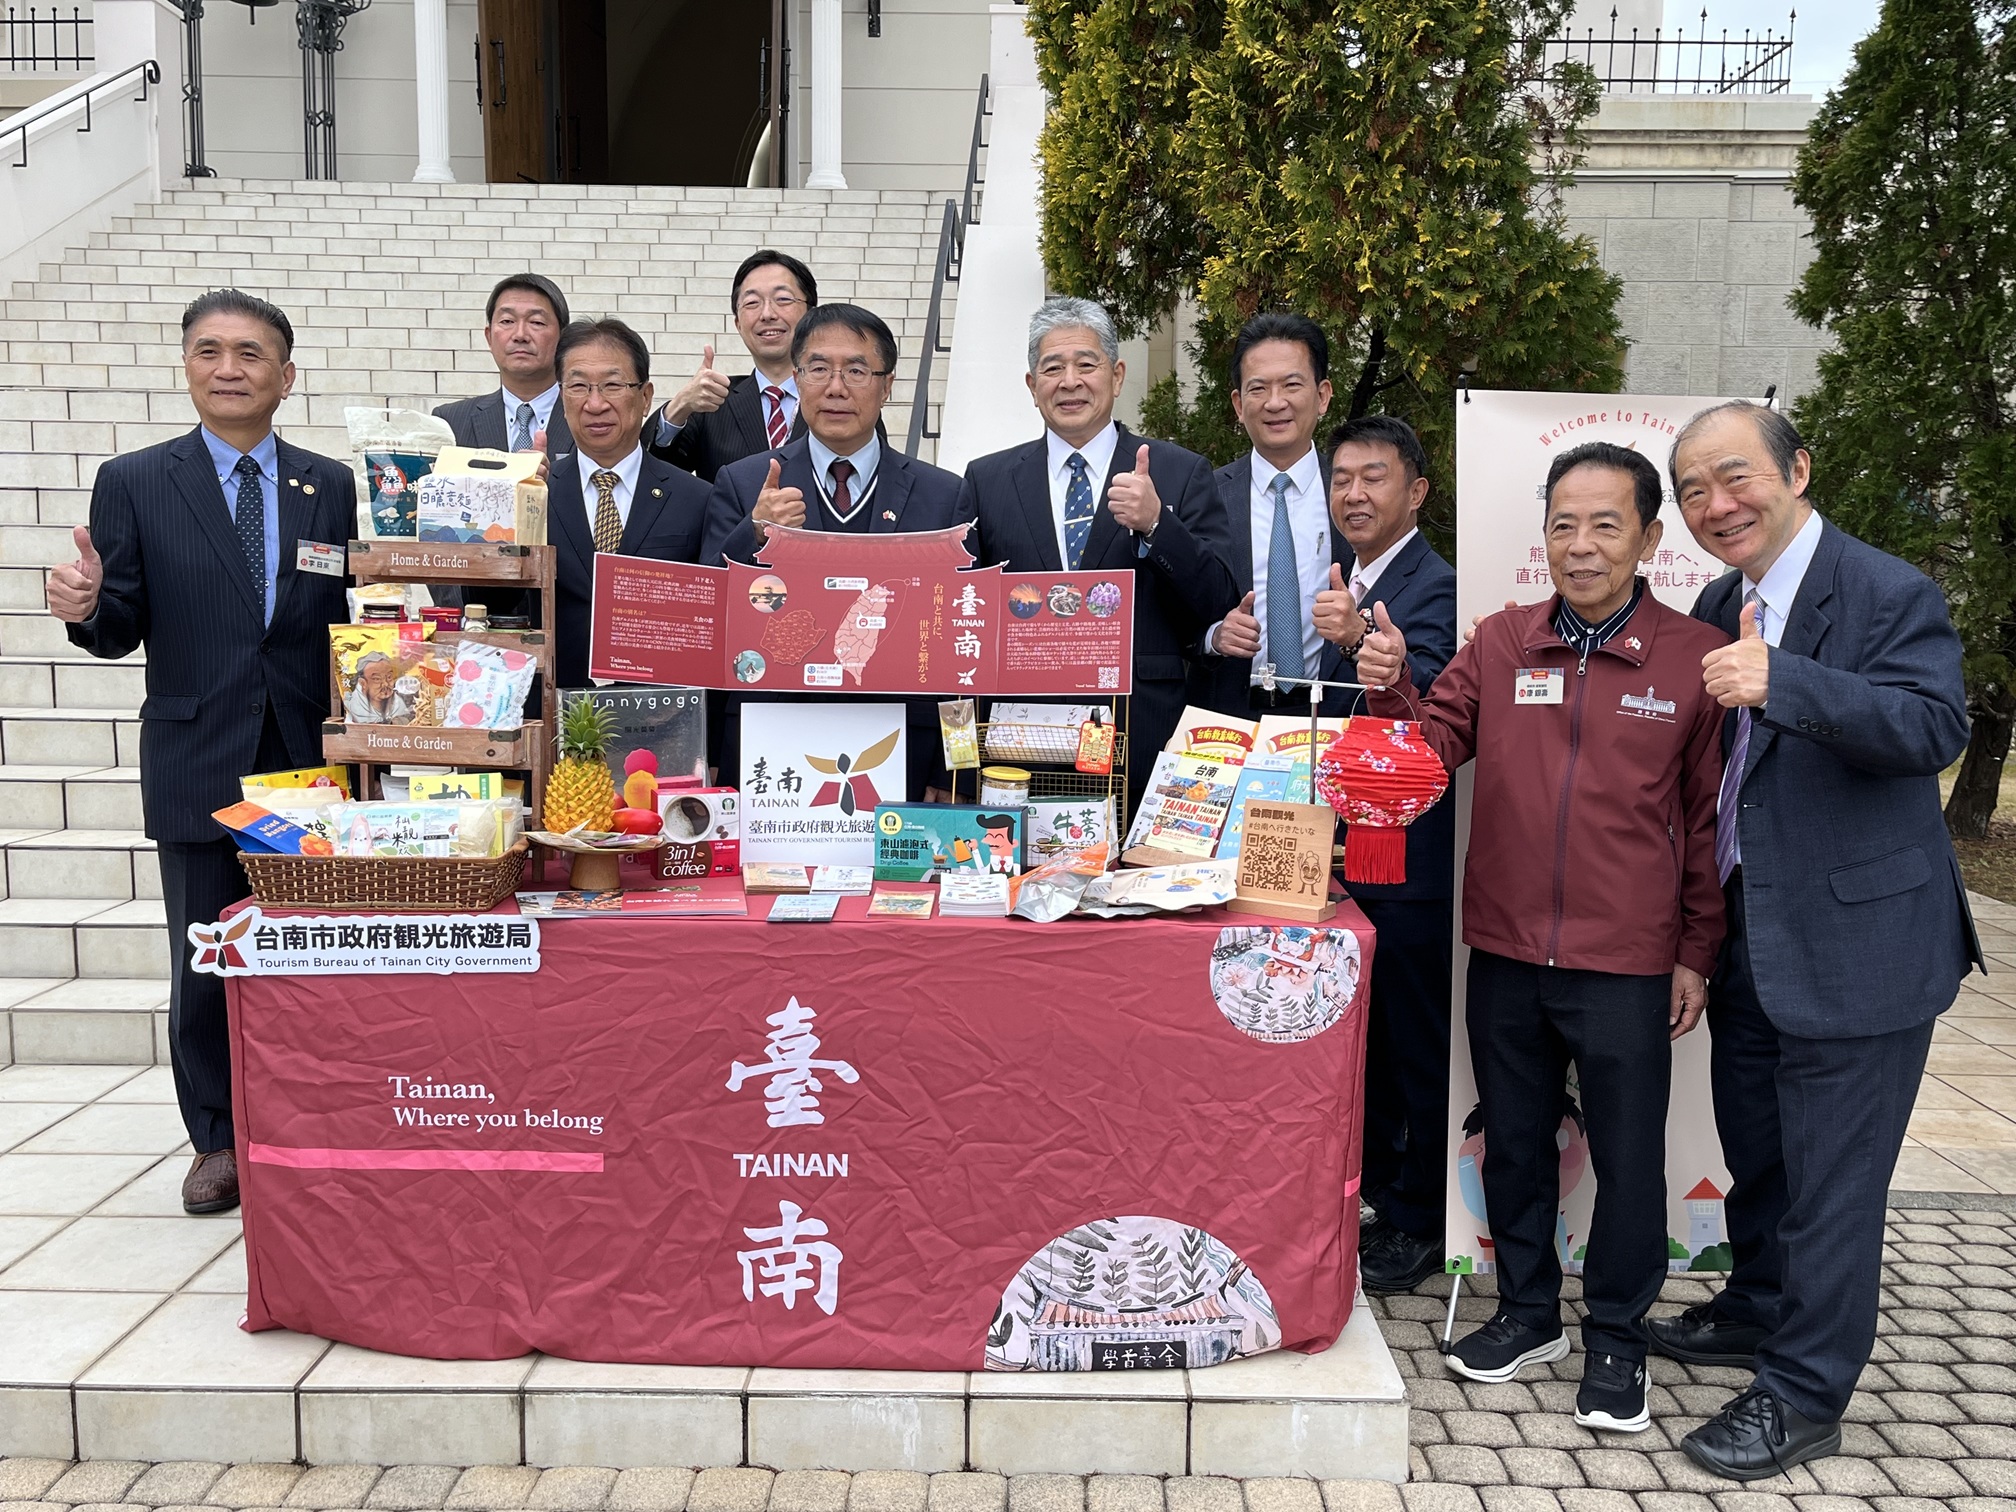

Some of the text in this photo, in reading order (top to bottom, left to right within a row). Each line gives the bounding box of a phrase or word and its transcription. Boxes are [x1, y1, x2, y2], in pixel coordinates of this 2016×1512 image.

[1539, 411, 1608, 447] Welcome
[1617, 409, 1633, 422] to
[391, 553, 468, 568] Home & Garden
[1529, 545, 1545, 563] 熊
[952, 582, 986, 616] 臺
[952, 619, 985, 627] TAINAN
[953, 629, 982, 660] 南
[609, 656, 632, 664] Tainan,
[636, 664, 653, 672] belong
[367, 733, 453, 750] Home & Garden
[746, 756, 802, 794] 臺南
[1194, 764, 1219, 778] 台南
[750, 798, 799, 808] TAINAN
[1162, 798, 1199, 815] TAINAN
[1193, 814, 1217, 824] TAINAN
[1249, 822, 1316, 836] #台南へ行きたいな
[664, 845, 697, 861] 3in1
[880, 849, 919, 860] 經典咖啡
[663, 860, 706, 877] coffee
[253, 923, 532, 951] 台南市政府観光旅遊局
[257, 955, 533, 969] Tourism Bureau of Tainan City Government
[724, 995, 860, 1129] 臺
[388, 1076, 495, 1104] Tainan,
[392, 1107, 604, 1135] Where you belong
[733, 1153, 848, 1178] TAINAN
[737, 1199, 843, 1316] 南
